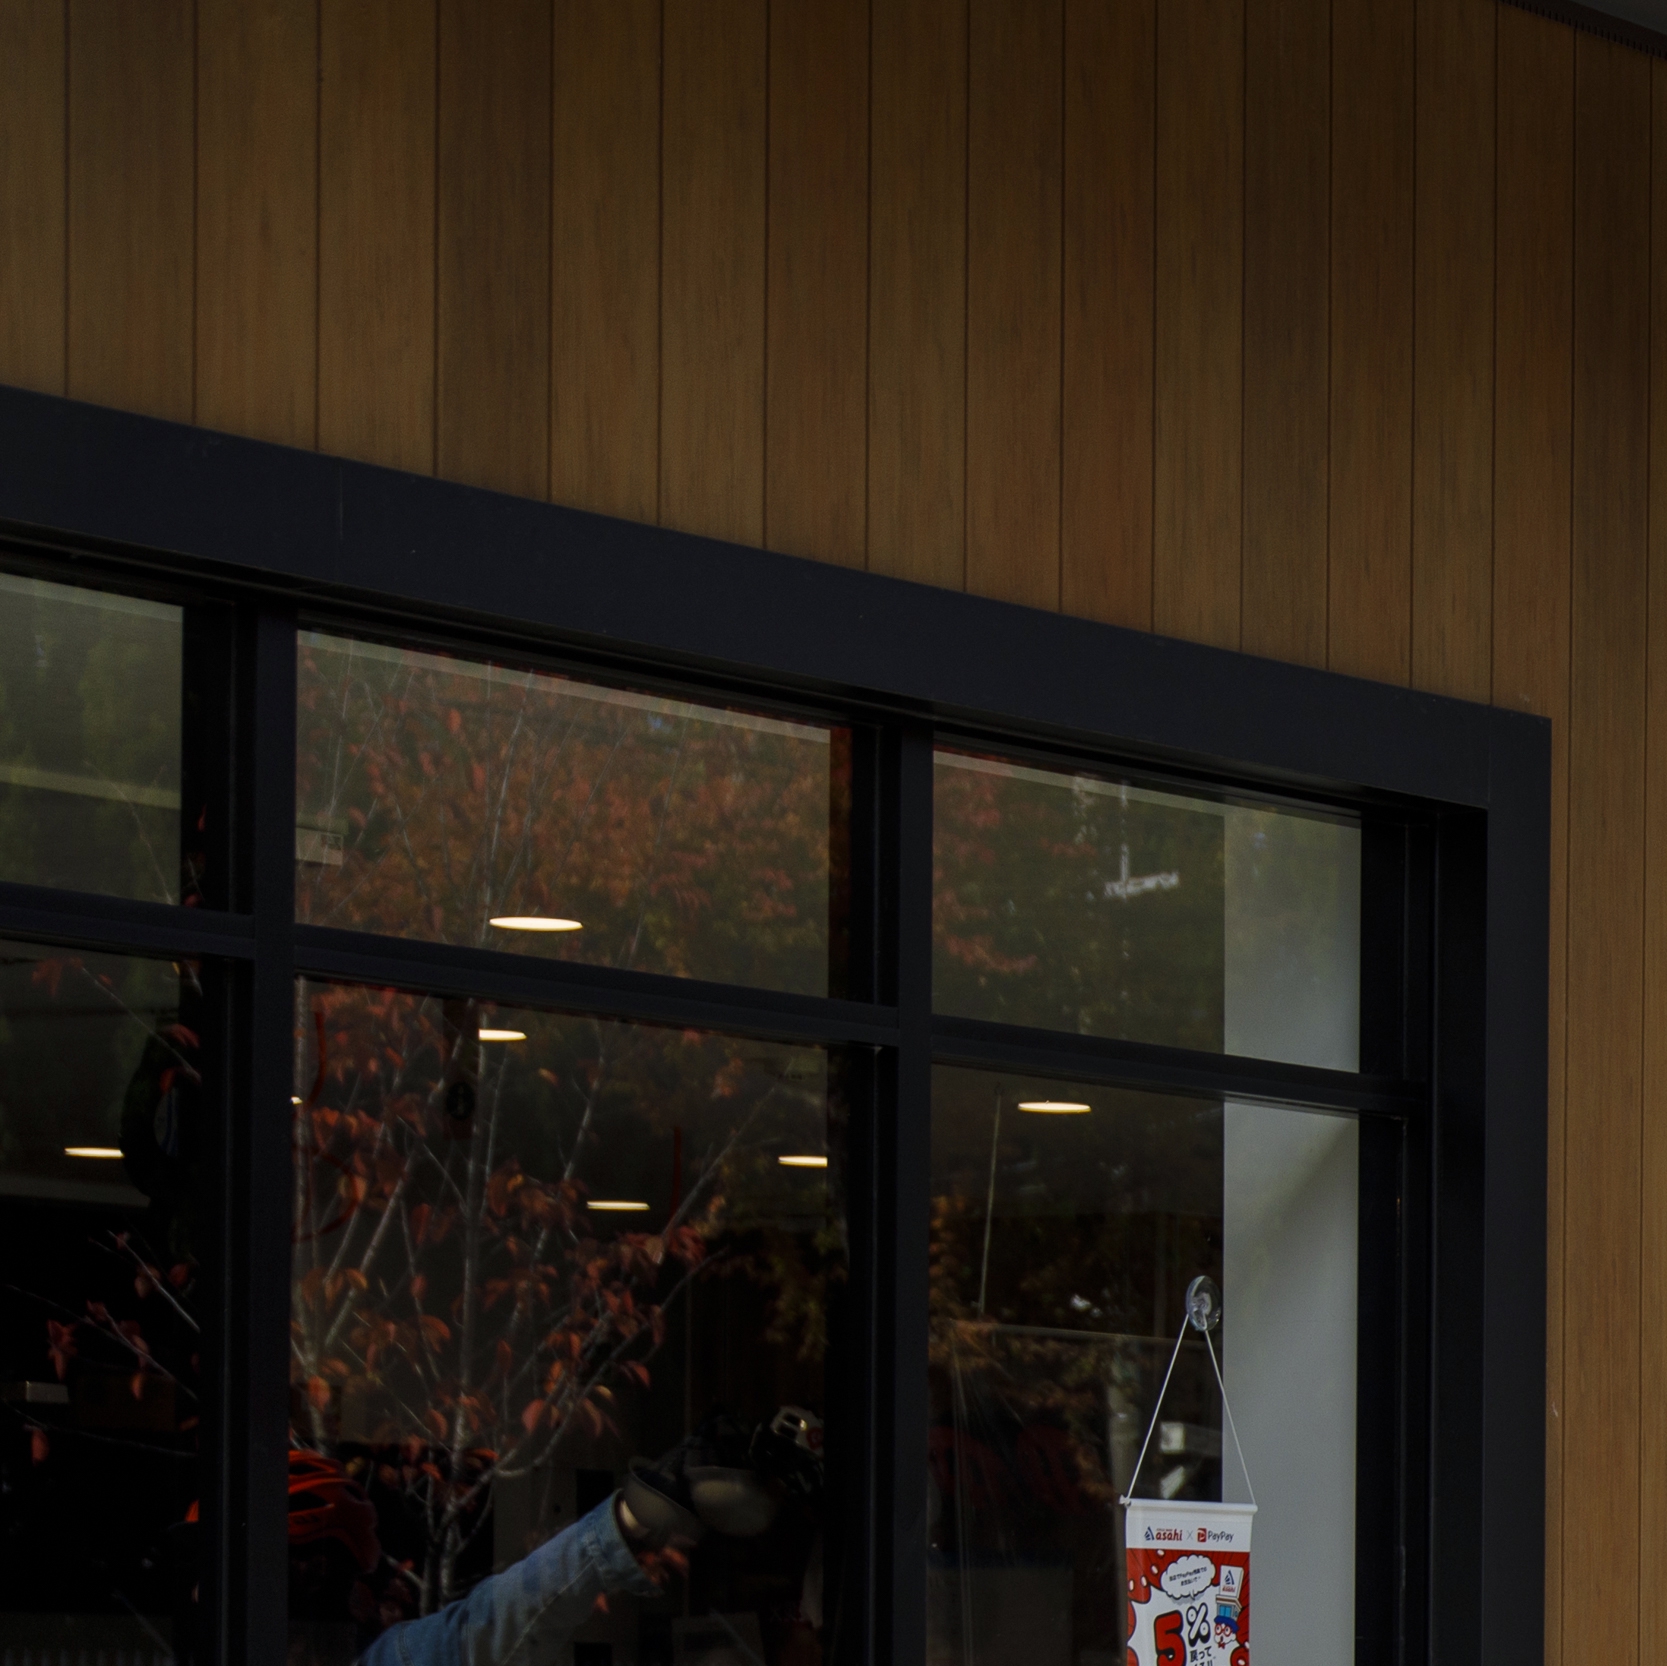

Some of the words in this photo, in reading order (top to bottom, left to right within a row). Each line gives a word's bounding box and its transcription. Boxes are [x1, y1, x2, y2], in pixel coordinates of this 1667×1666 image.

[1155, 1528, 1183, 1541] asahi
[1208, 1530, 1234, 1543] PayPay
[1190, 1646, 1212, 1663] 戻って
